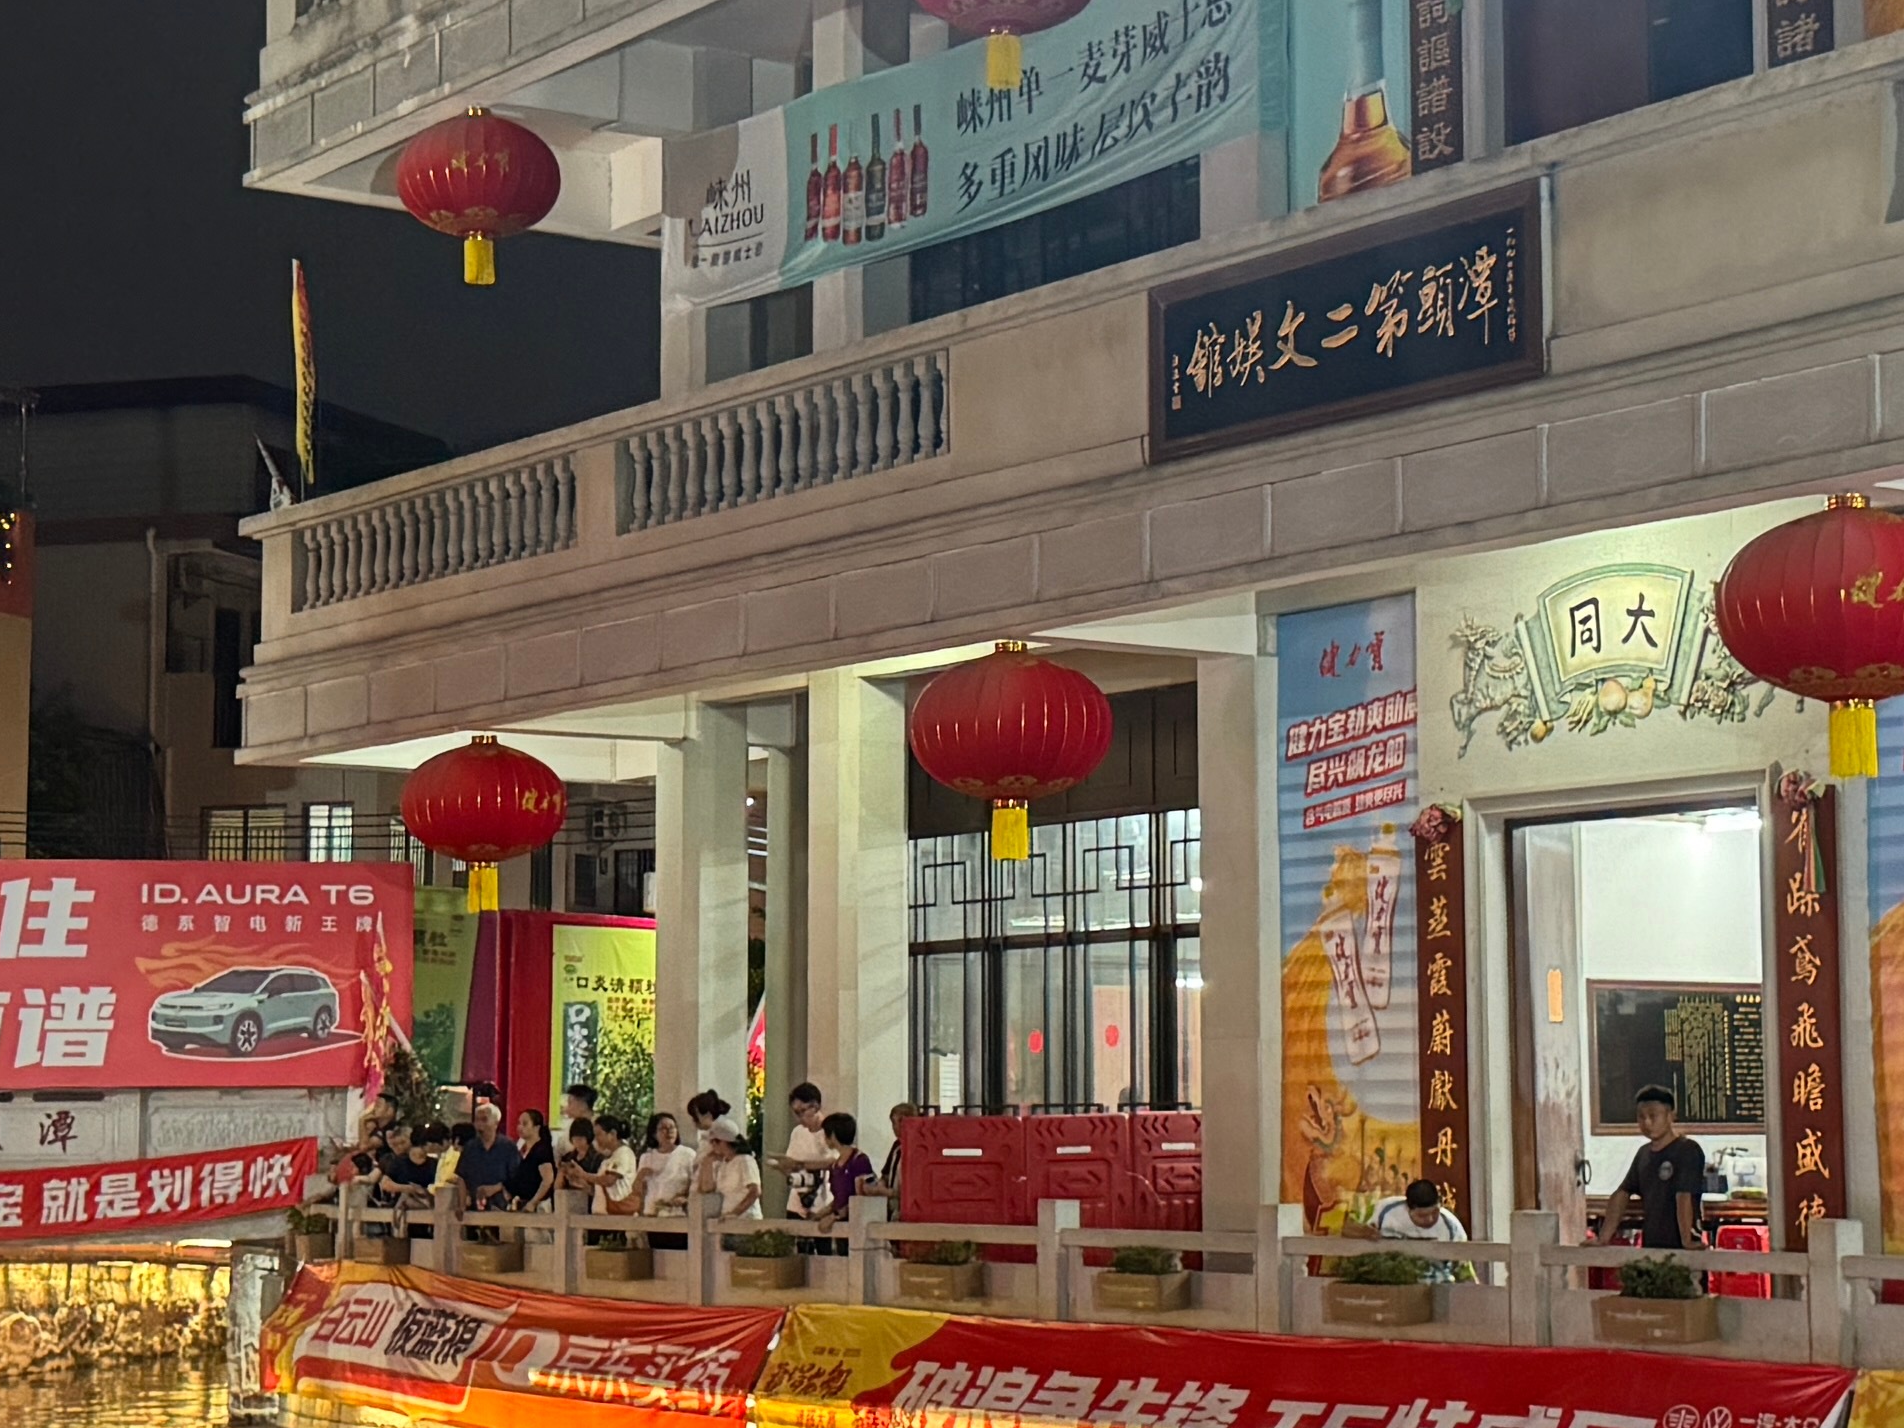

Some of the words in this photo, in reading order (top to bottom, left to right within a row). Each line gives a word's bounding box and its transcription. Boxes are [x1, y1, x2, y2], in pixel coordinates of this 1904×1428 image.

[688, 203, 764, 237] LAIZHOU
[141, 884, 188, 905] ID.
[196, 884, 309, 905] AURA
[321, 884, 375, 905] T6
[142, 915, 374, 934] 德系智电新王牌
[1424, 843, 1458, 1212] 雲蒸霞蔚獻丹
[40, 1153, 292, 1225] 就是划得快
[311, 1299, 394, 1349] 白云山
